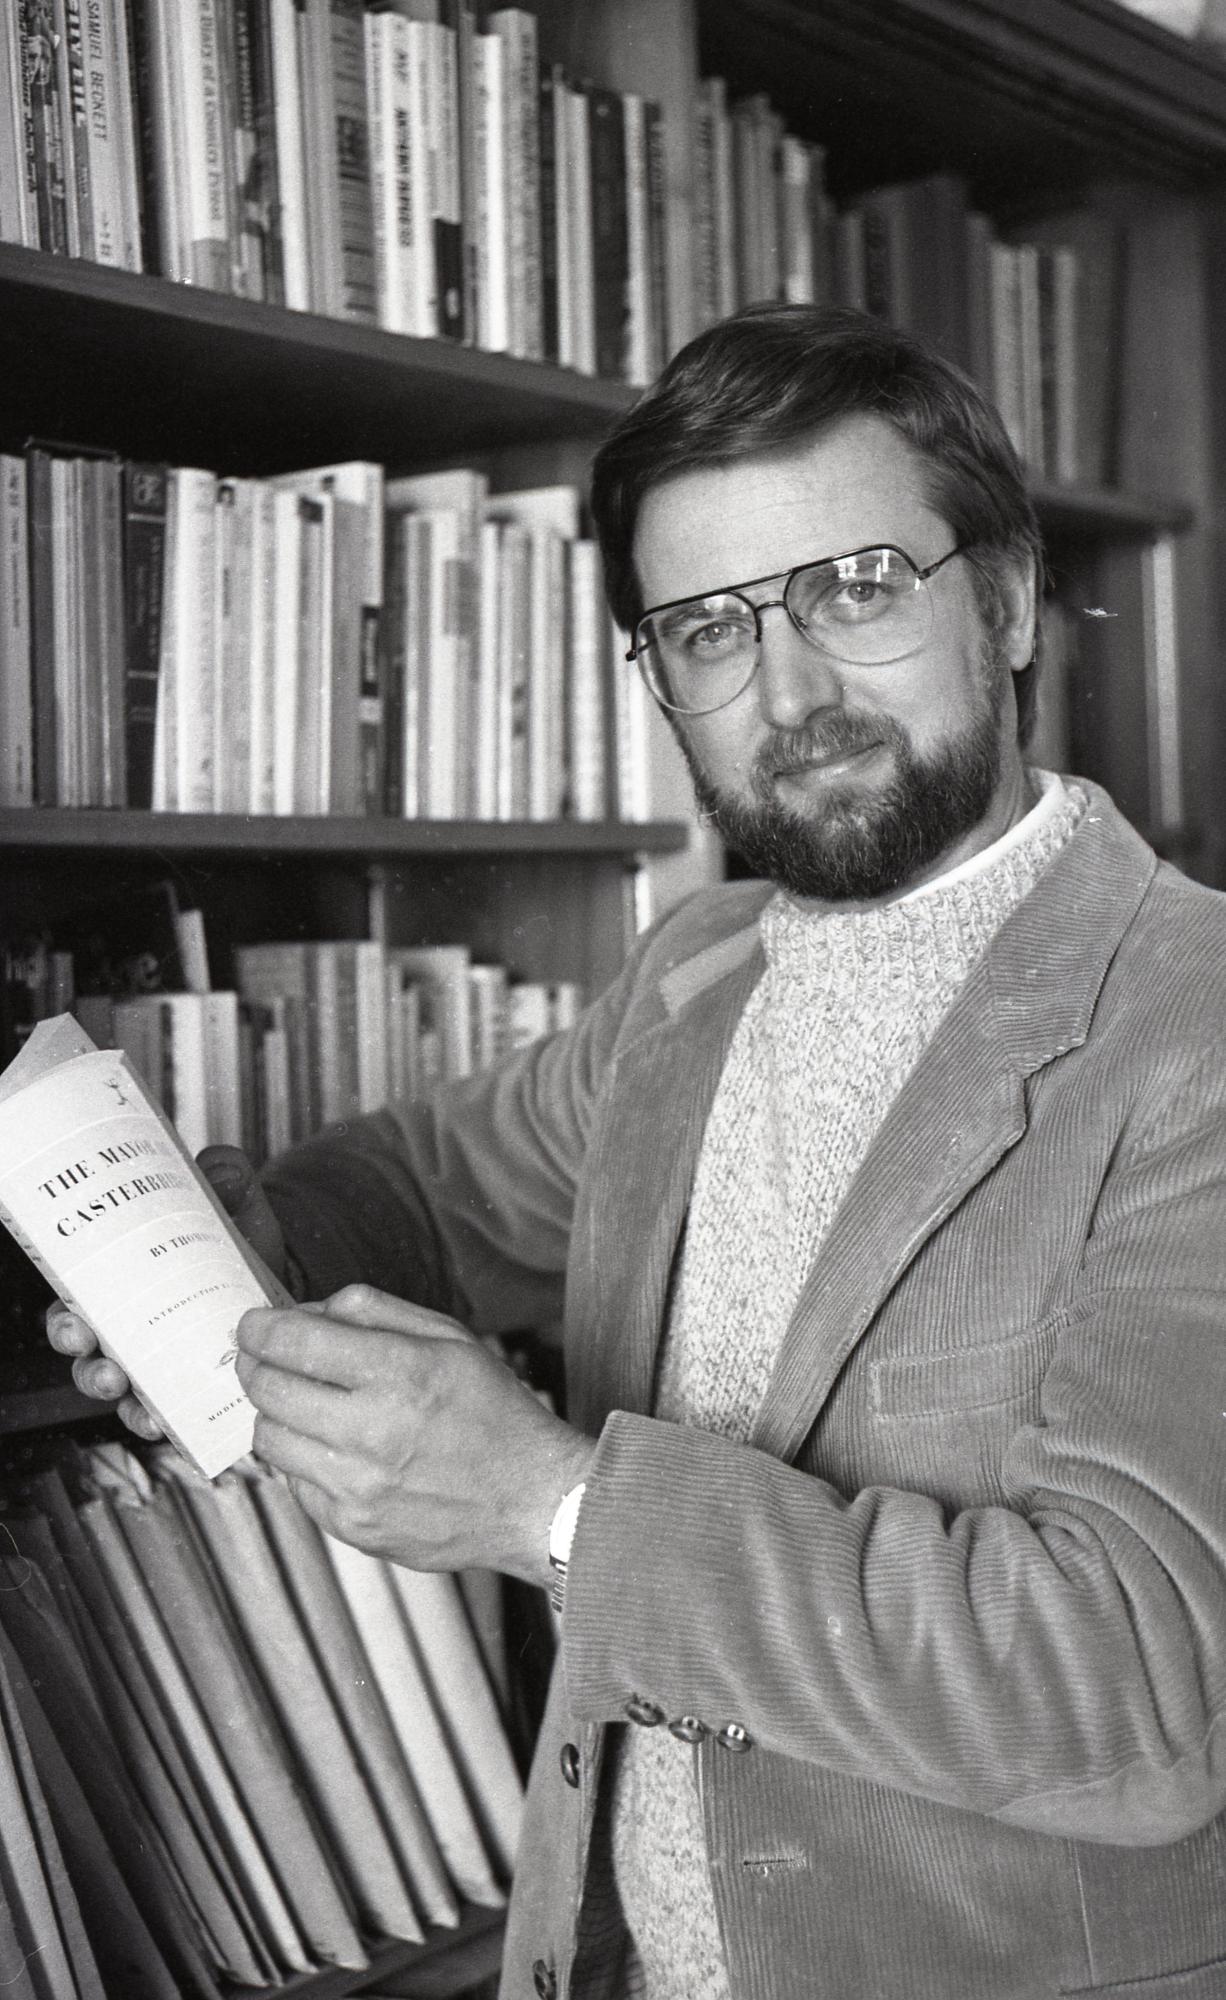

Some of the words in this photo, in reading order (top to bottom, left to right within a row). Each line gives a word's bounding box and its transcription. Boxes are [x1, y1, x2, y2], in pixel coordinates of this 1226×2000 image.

[87, 0, 102, 59] SAMUEL
[90, 70, 107, 140] BECKETT
[38, 1159, 96, 1199] THE
[57, 1172, 194, 1237] CASTERBRI
[149, 1242, 168, 1258] BY
[148, 1284, 220, 1325] INTRODUCTION
